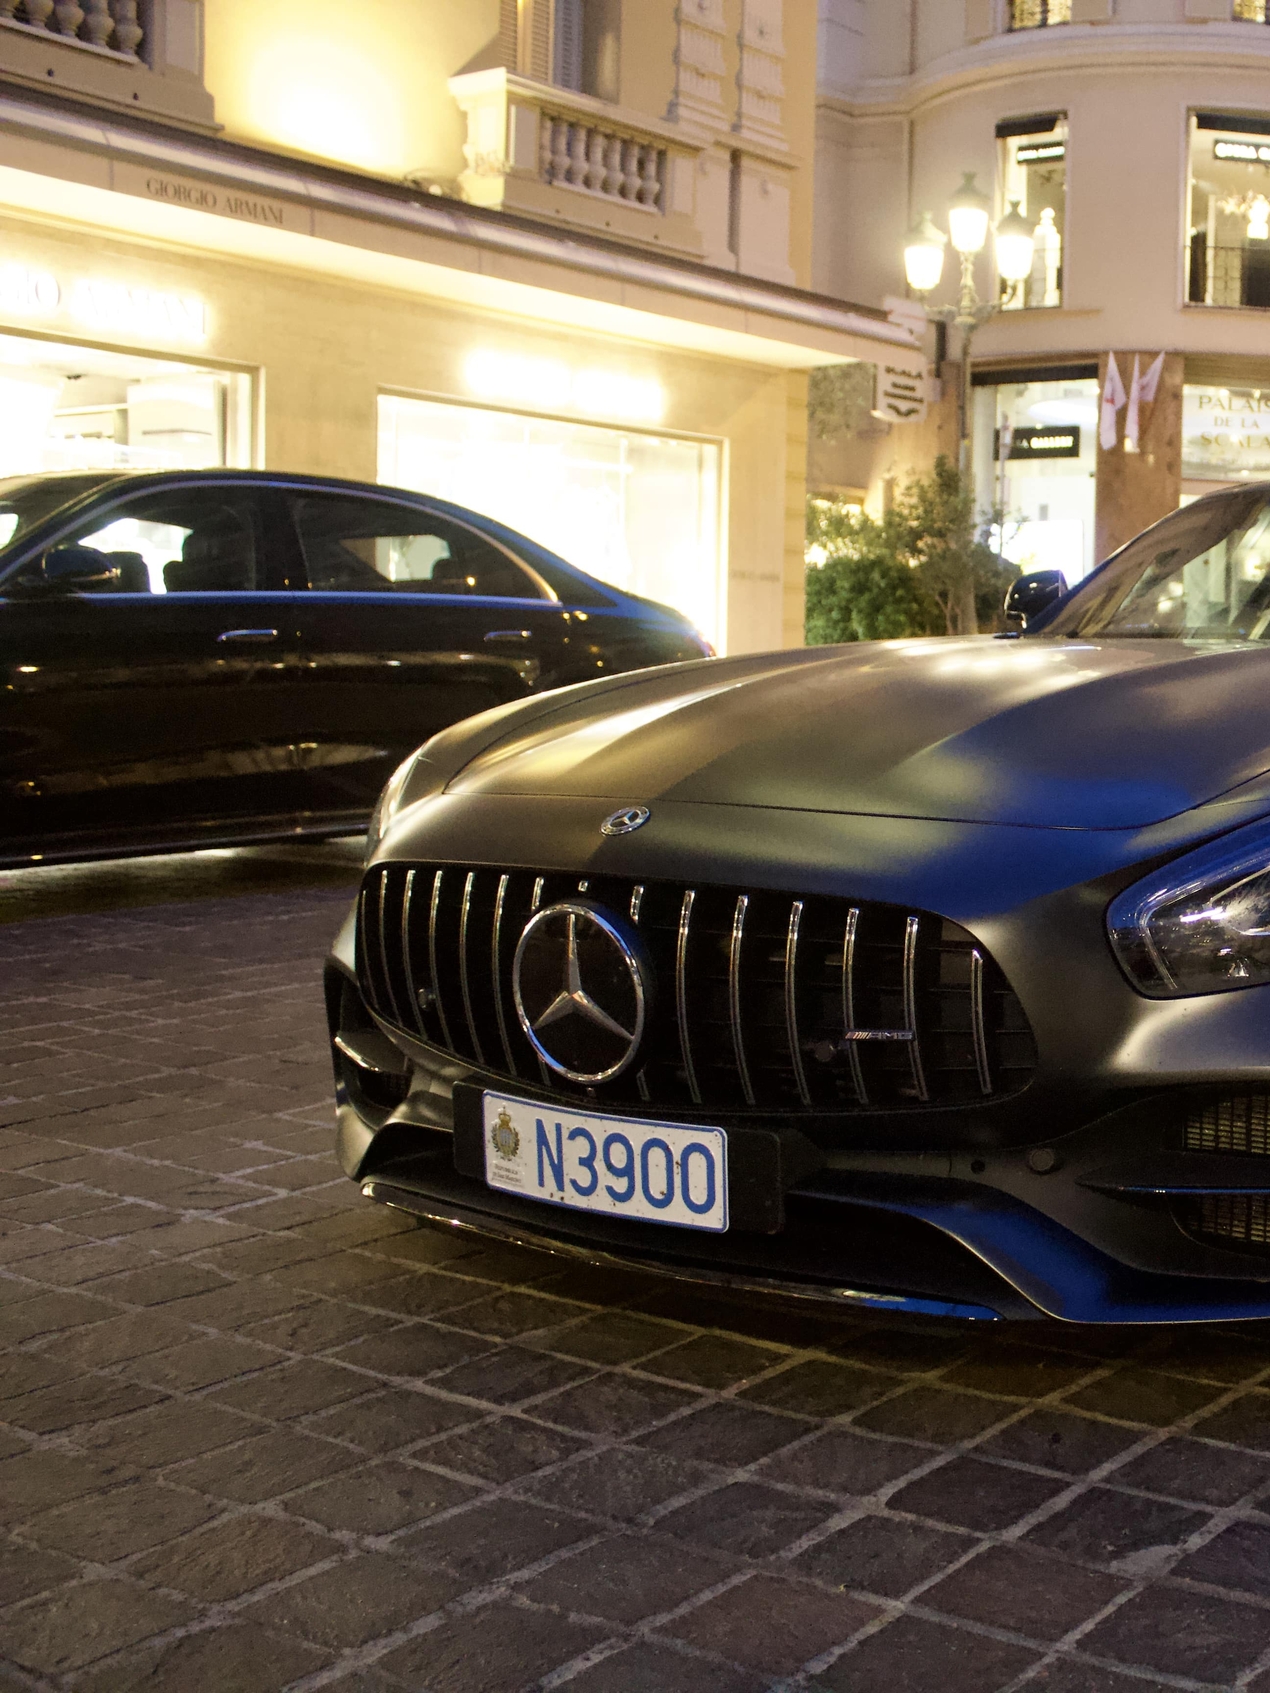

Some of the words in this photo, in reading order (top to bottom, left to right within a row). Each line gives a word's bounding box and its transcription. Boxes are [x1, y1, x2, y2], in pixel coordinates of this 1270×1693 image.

[146, 177, 217, 208] GIORGIO
[223, 198, 284, 224] ARMANI
[1214, 416, 1233, 427] DE
[1241, 418, 1260, 429] LA
[535, 1118, 717, 1214] N3900
